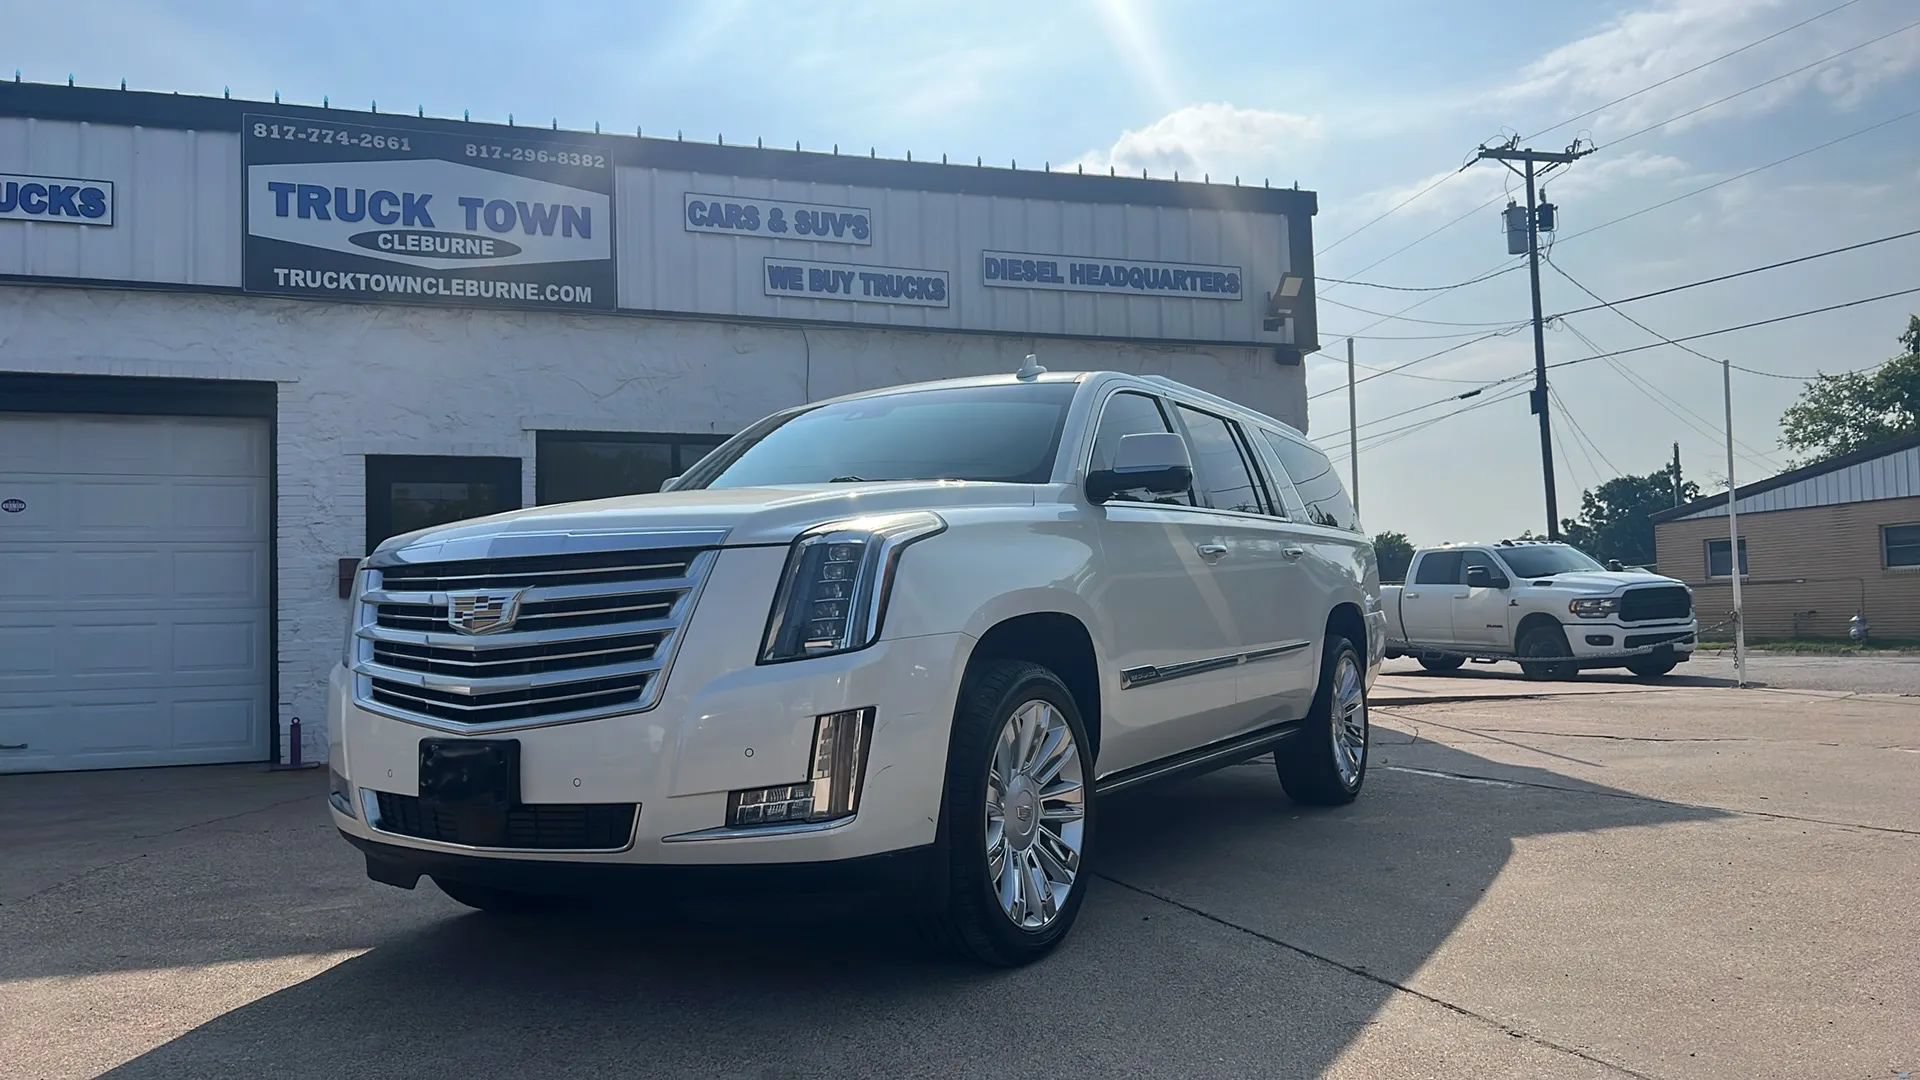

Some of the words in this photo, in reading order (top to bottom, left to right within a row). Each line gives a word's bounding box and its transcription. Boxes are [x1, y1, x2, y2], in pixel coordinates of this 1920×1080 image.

[253, 123, 411, 151] 817-774-2661
[465, 143, 605, 169] 817-296-8382
[268, 181, 435, 228] TRUCK
[458, 197, 592, 239] TOWN
[687, 200, 761, 231] CARS
[767, 207, 788, 234] &
[794, 210, 869, 240] SUV'S
[377, 233, 495, 256] CLEBURNE
[273, 267, 592, 303] TRUCKTOWNCLEBURNE.COM
[767, 265, 804, 291] WE
[809, 268, 855, 294] BUY
[859, 272, 946, 301] TRUCKS
[984, 257, 1065, 284] DIESEL
[1069, 263, 1240, 294] HEADQUARTERS
